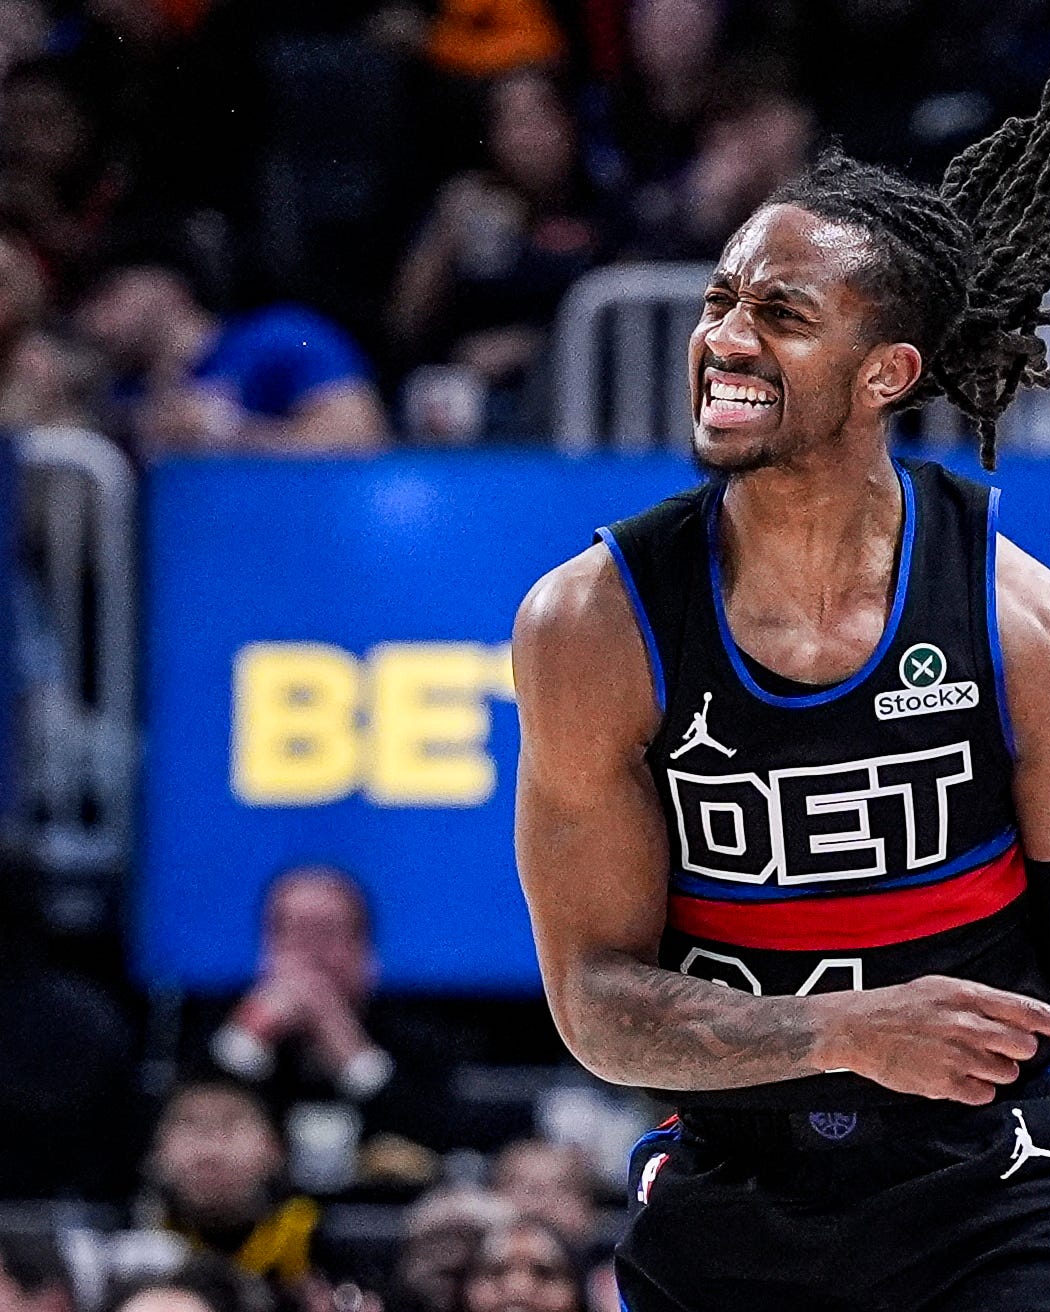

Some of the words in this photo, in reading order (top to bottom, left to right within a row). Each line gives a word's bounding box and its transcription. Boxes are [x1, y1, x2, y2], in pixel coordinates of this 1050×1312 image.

[232, 642, 516, 806] BE
[878, 684, 974, 715] StockX
[667, 740, 973, 886] DET
